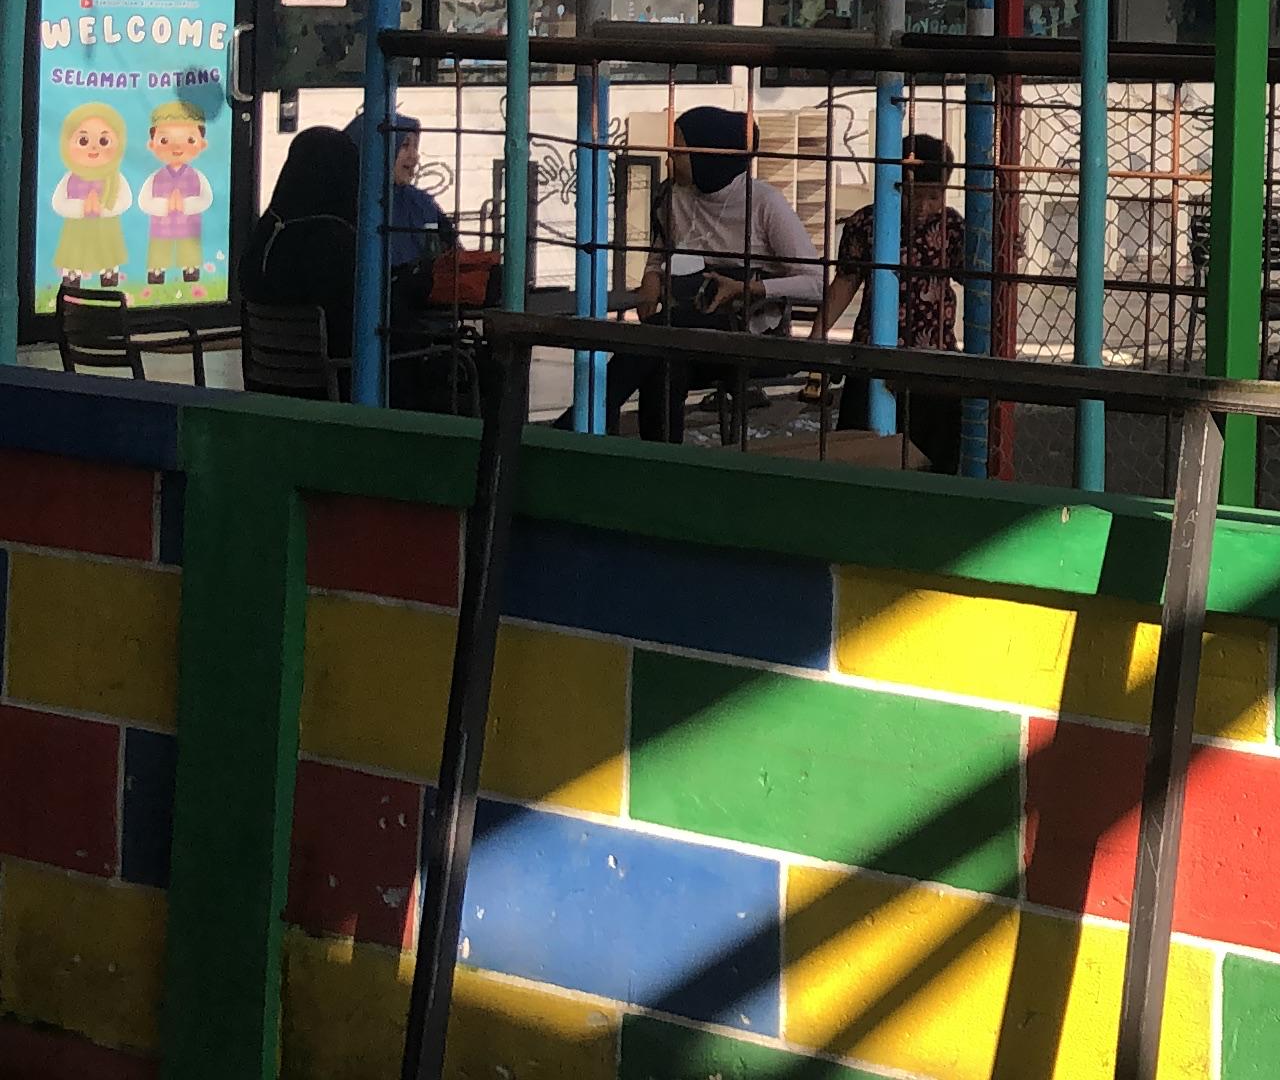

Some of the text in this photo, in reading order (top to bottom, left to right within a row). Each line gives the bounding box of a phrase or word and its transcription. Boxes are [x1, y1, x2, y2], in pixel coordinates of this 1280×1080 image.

[41, 15, 227, 50] WELCOME
[51, 67, 221, 89] SELAMAT DATANG
